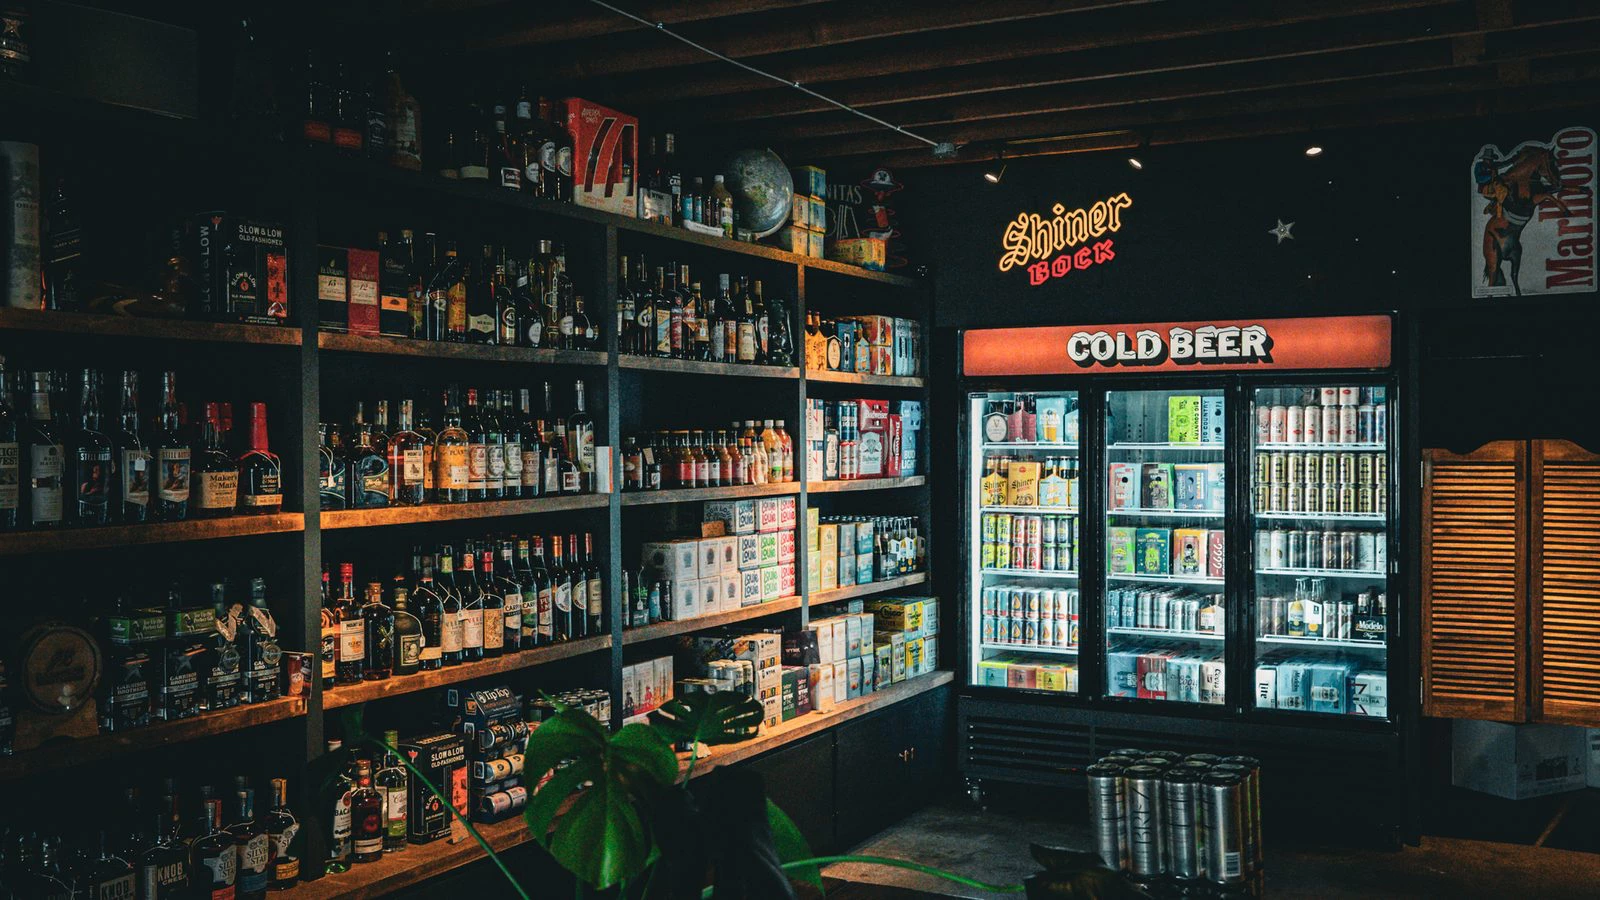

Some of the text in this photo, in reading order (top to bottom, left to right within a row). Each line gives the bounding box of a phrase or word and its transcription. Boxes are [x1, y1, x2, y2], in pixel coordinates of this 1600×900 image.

[1538, 129, 1593, 289] Marlboro
[238, 224, 261, 235] SLOW
[267, 229, 282, 238] LOW
[998, 191, 1133, 272] Shiner
[200, 226, 209, 256] LOW
[1027, 239, 1116, 286] BOCK
[1067, 325, 1273, 366] COLD BEER
[218, 480, 237, 489] Mark
[984, 480, 1007, 491] Shiner
[1011, 478, 1034, 489] Shiner
[1359, 620, 1384, 630] Modelo
[1259, 682, 1269, 699] lite
[431, 751, 447, 762] SLOW
[452, 746, 464, 756] LOW
[158, 862, 184, 883] KNOB
[101, 879, 129, 900] KNOB
